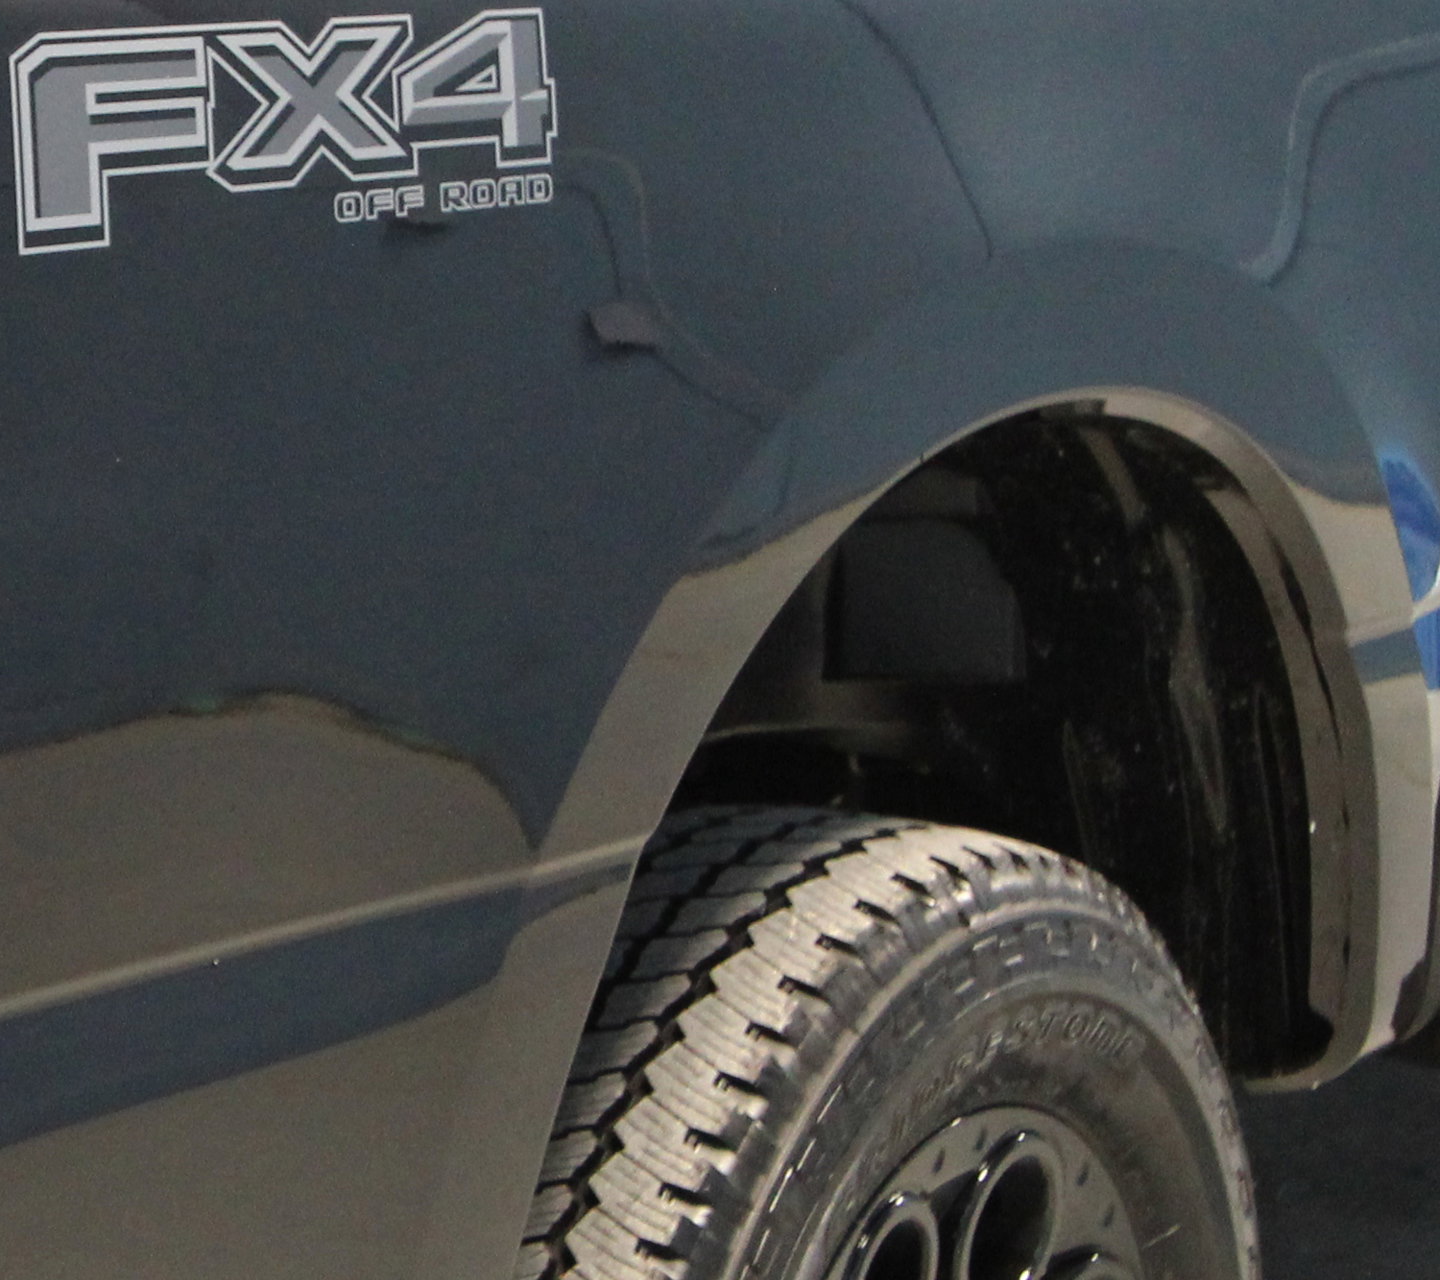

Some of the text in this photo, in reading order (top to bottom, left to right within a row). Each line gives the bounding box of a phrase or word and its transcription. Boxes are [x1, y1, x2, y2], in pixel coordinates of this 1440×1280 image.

[9, 7, 558, 255] FX4
[334, 173, 553, 222] OFF ROAD
